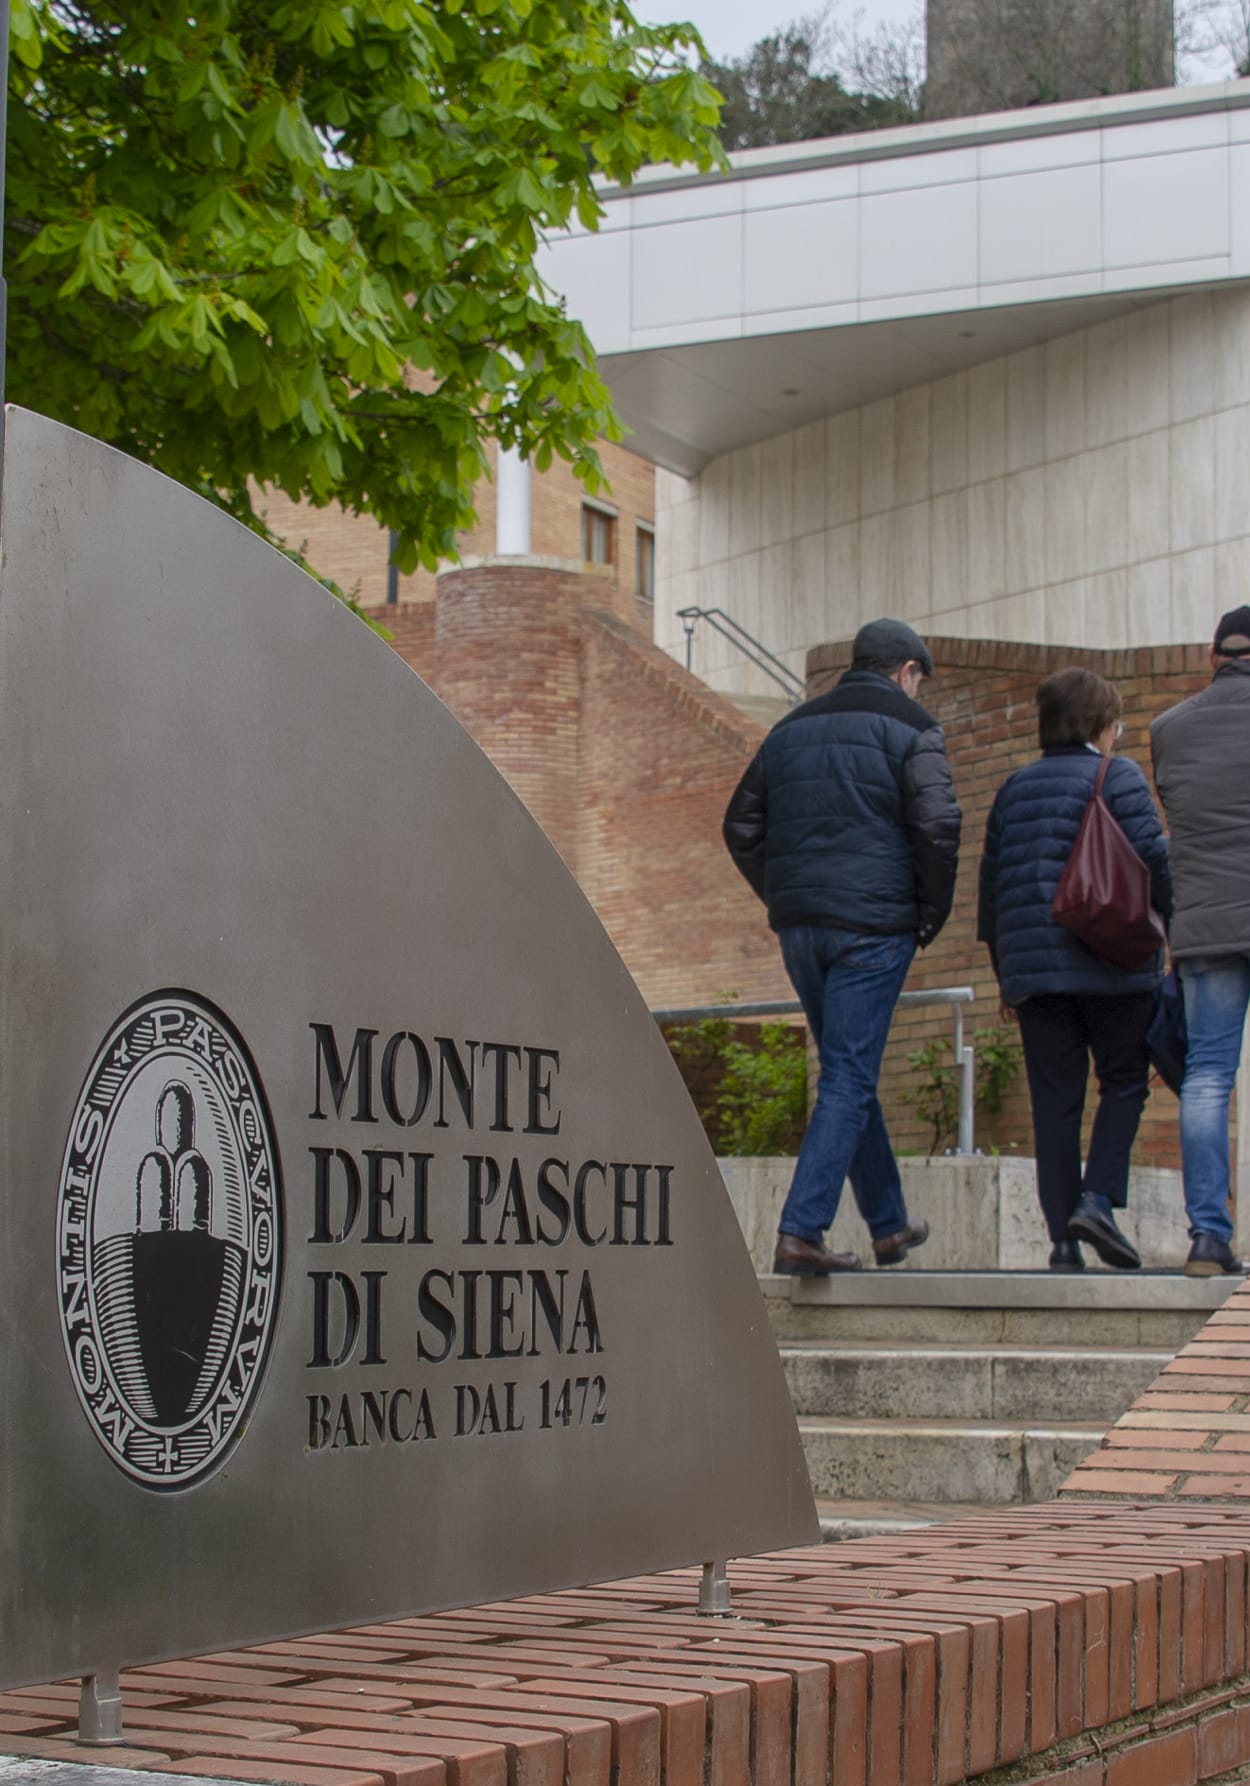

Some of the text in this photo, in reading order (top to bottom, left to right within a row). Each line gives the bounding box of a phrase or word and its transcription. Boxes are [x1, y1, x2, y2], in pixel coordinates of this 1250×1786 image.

[308, 1021, 562, 1136] MONTE
[307, 1146, 675, 1247] DEI PASCHI
[305, 1268, 605, 1369] DI SIENA
[305, 1374, 608, 1453] BANCA DAL 1472
